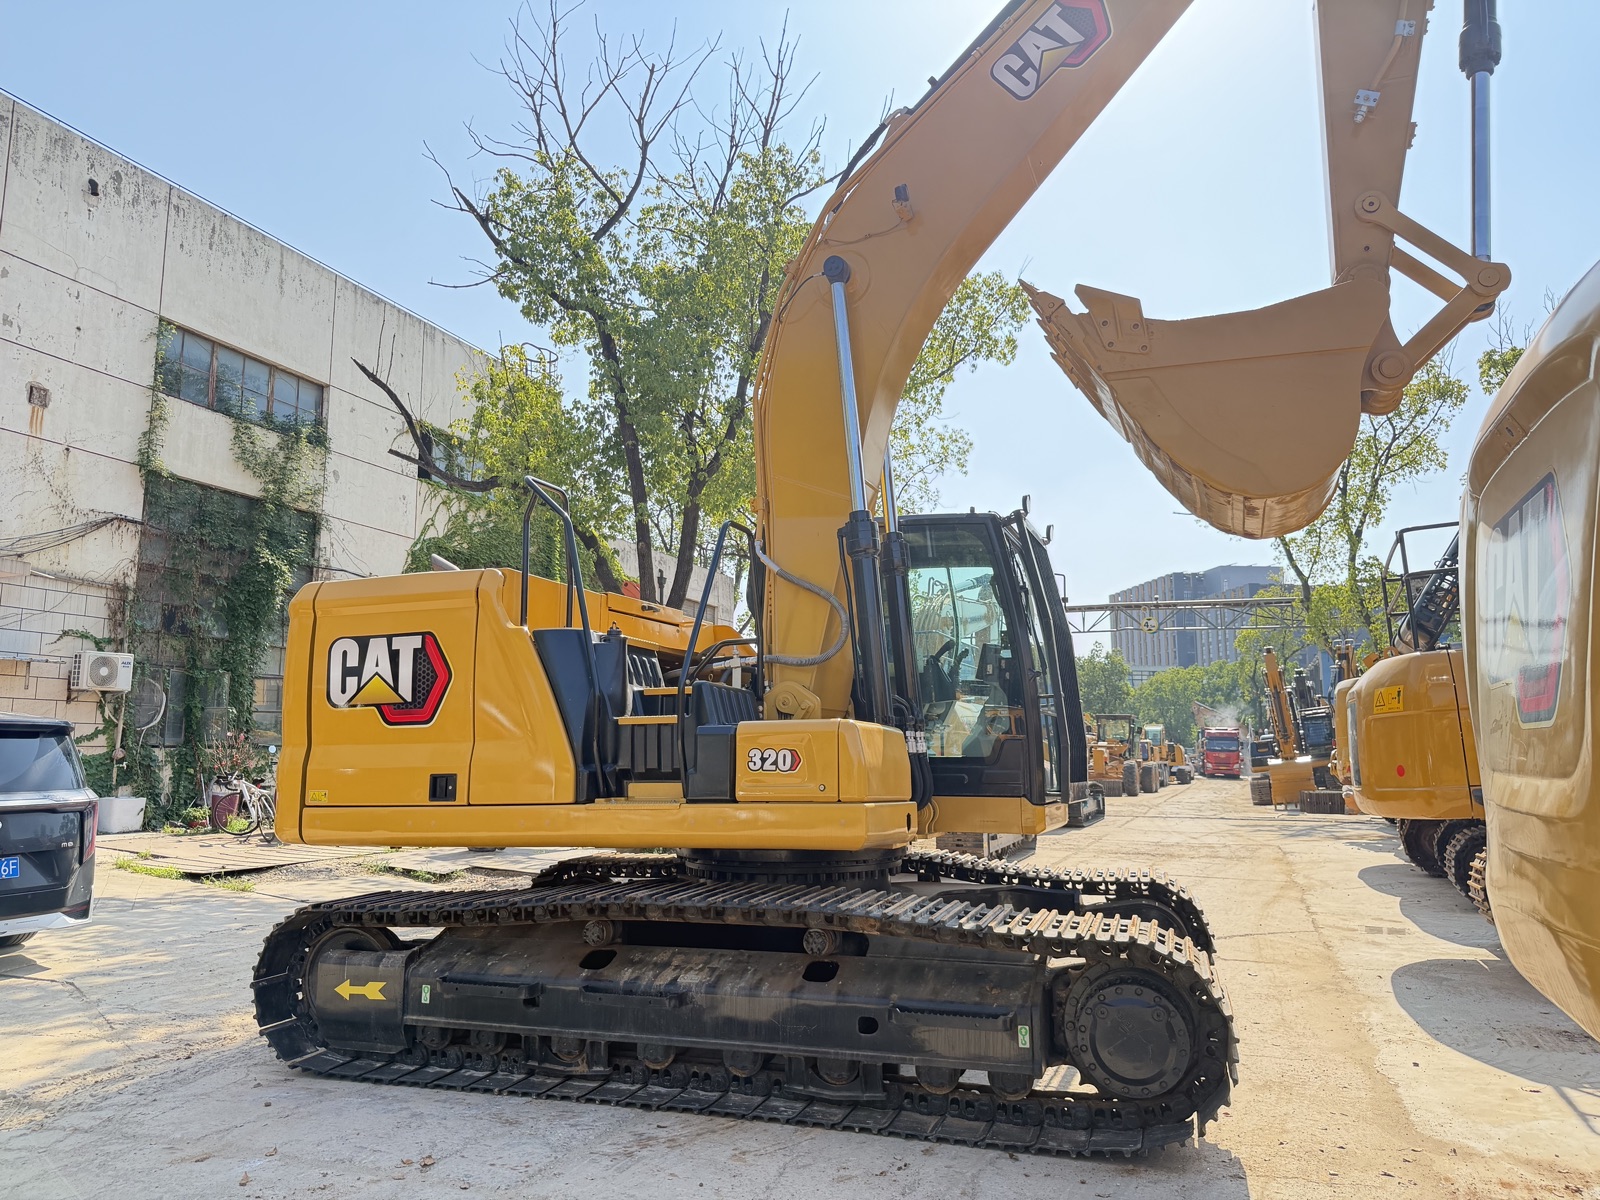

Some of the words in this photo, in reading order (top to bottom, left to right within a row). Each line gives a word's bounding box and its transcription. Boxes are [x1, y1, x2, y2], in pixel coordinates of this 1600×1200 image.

[992, 4, 1085, 97] CAT
[1486, 487, 1545, 680] CAT
[329, 635, 423, 706] CAT
[748, 748, 792, 771] 320
[1, 859, 18, 875] 6F
